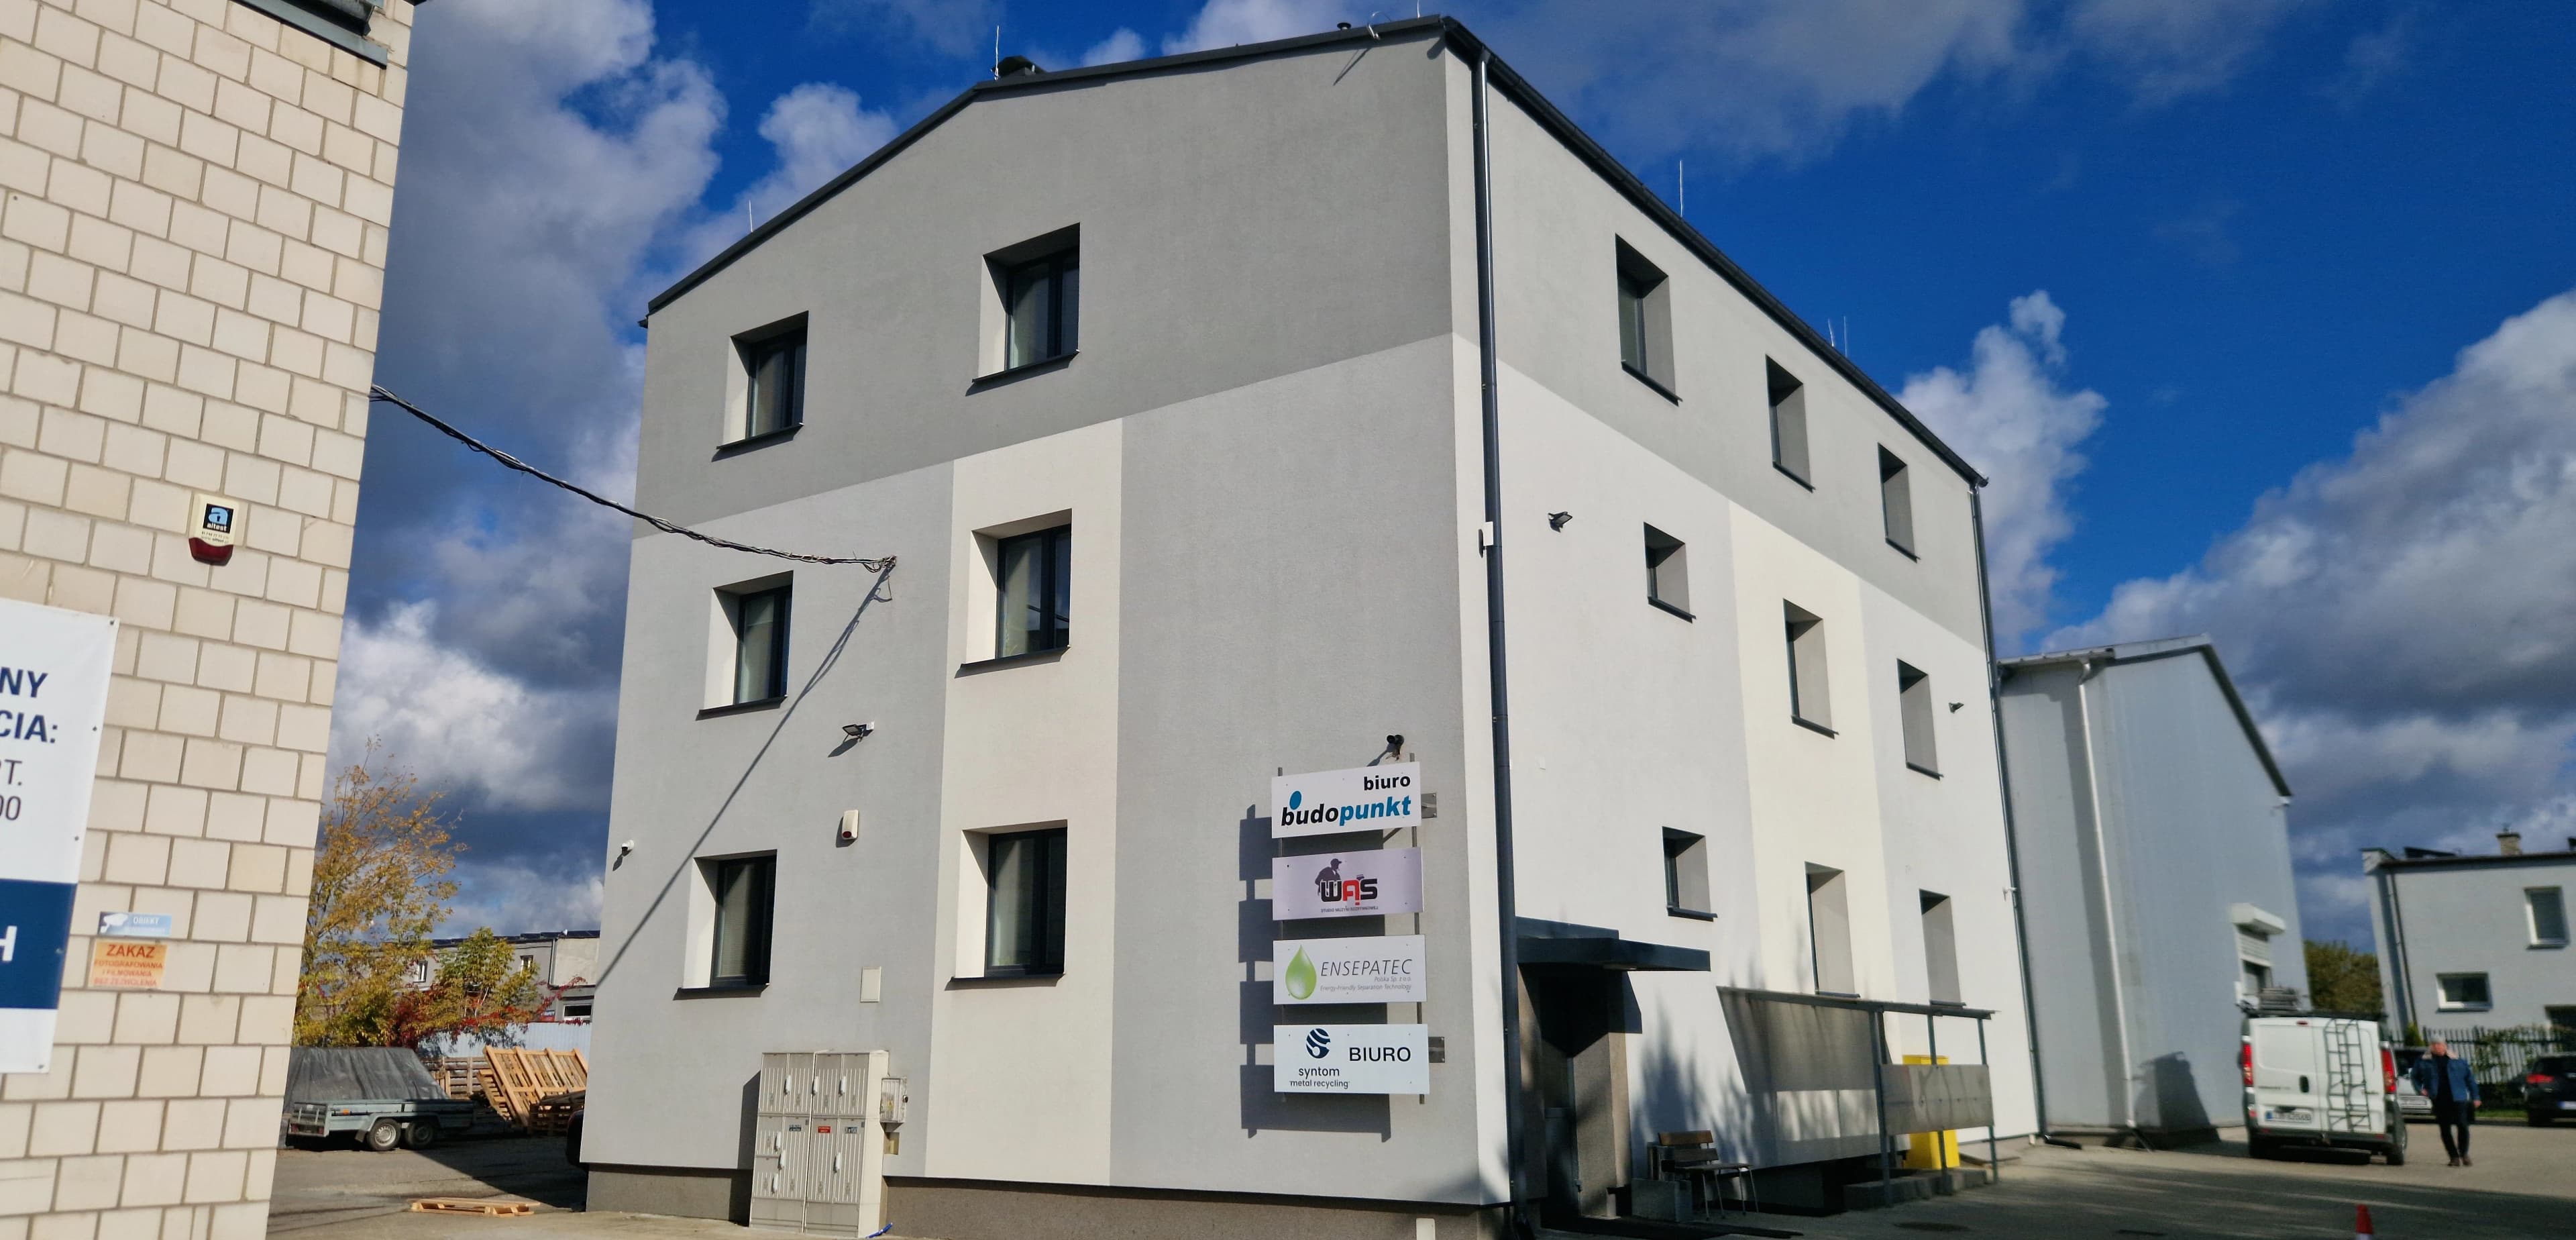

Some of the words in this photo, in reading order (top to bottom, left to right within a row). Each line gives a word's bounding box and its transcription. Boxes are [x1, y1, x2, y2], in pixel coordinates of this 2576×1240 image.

[0, 758, 23, 785] T.
[1364, 776, 1411, 790] biuro
[1281, 795, 1411, 826] budopunkt
[106, 944, 156, 958] ZAKAZ
[1321, 959, 1412, 976] ENSEPATEC
[1349, 1047, 1411, 1062] BIURO
[1298, 1066, 1340, 1080] syntom
[1313, 1079, 1348, 1090] recycling
